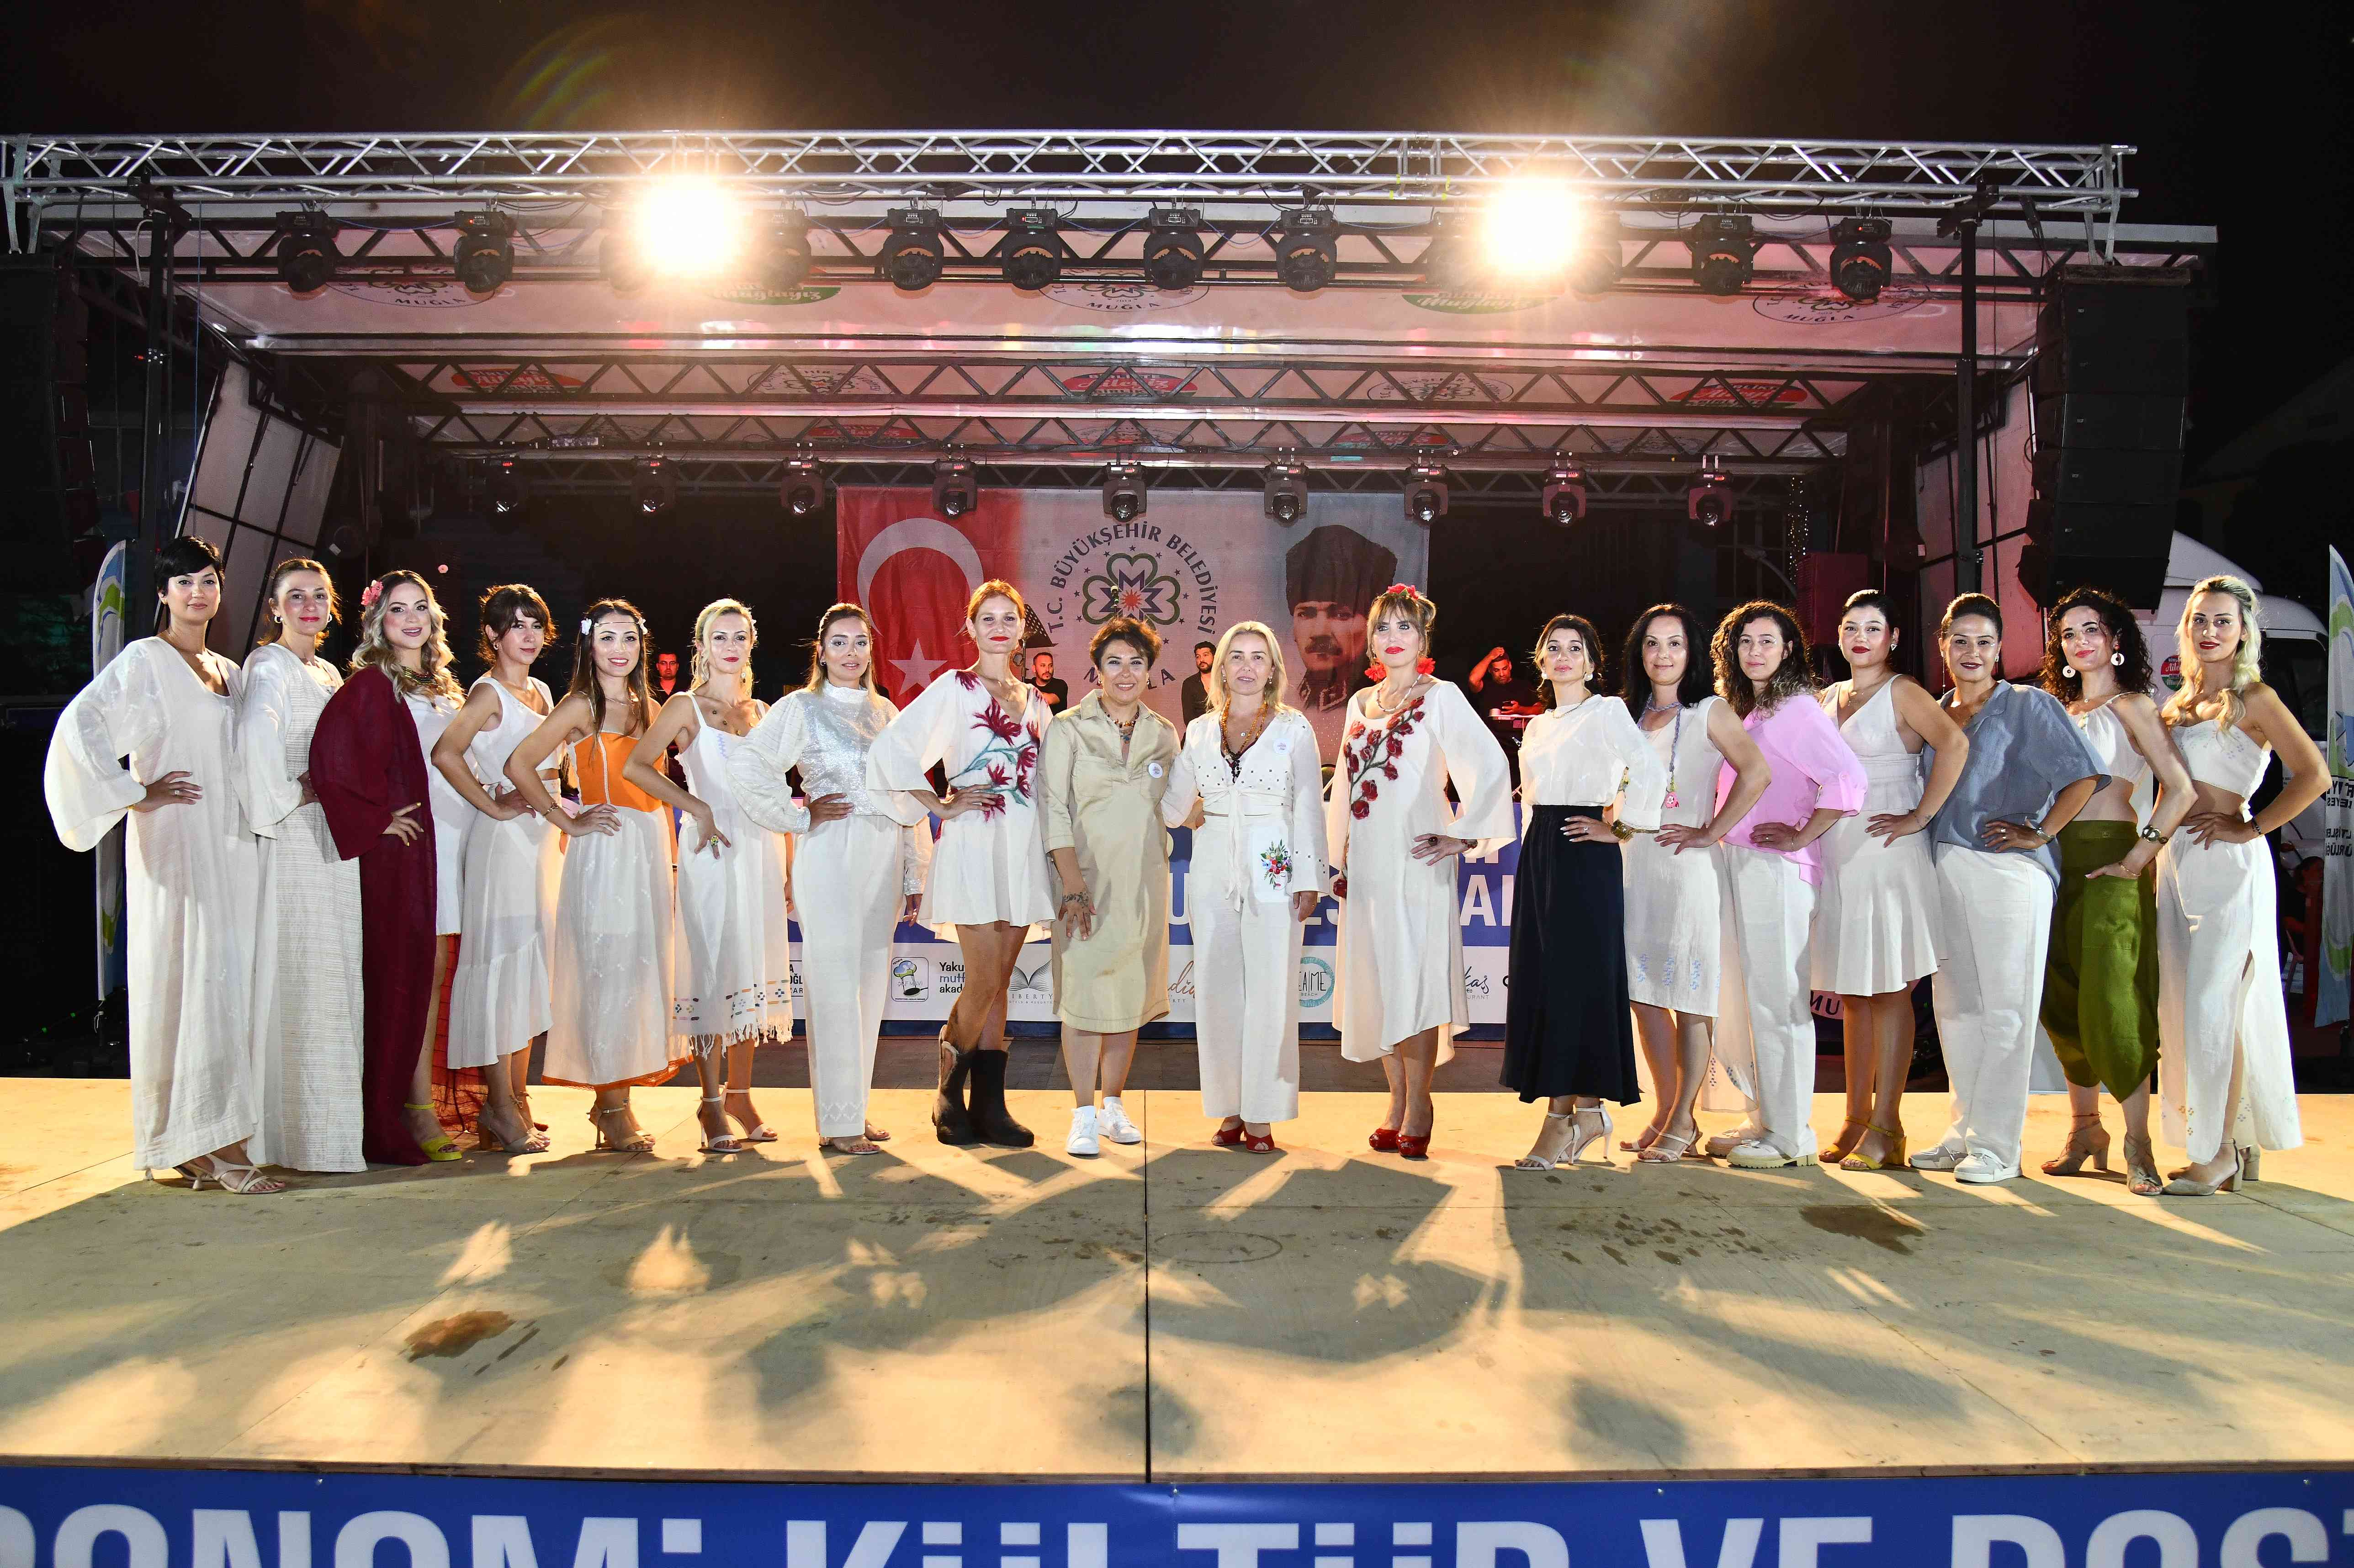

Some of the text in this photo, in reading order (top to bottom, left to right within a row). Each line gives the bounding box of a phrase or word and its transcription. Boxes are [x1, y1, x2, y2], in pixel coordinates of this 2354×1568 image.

[1047, 521, 1218, 635] T.C. BÜYÜKŞEHİR BELEDİYESİ
[1083, 667, 1176, 690] MLA
[939, 961, 964, 971] Yaku
[939, 984, 962, 993] akad
